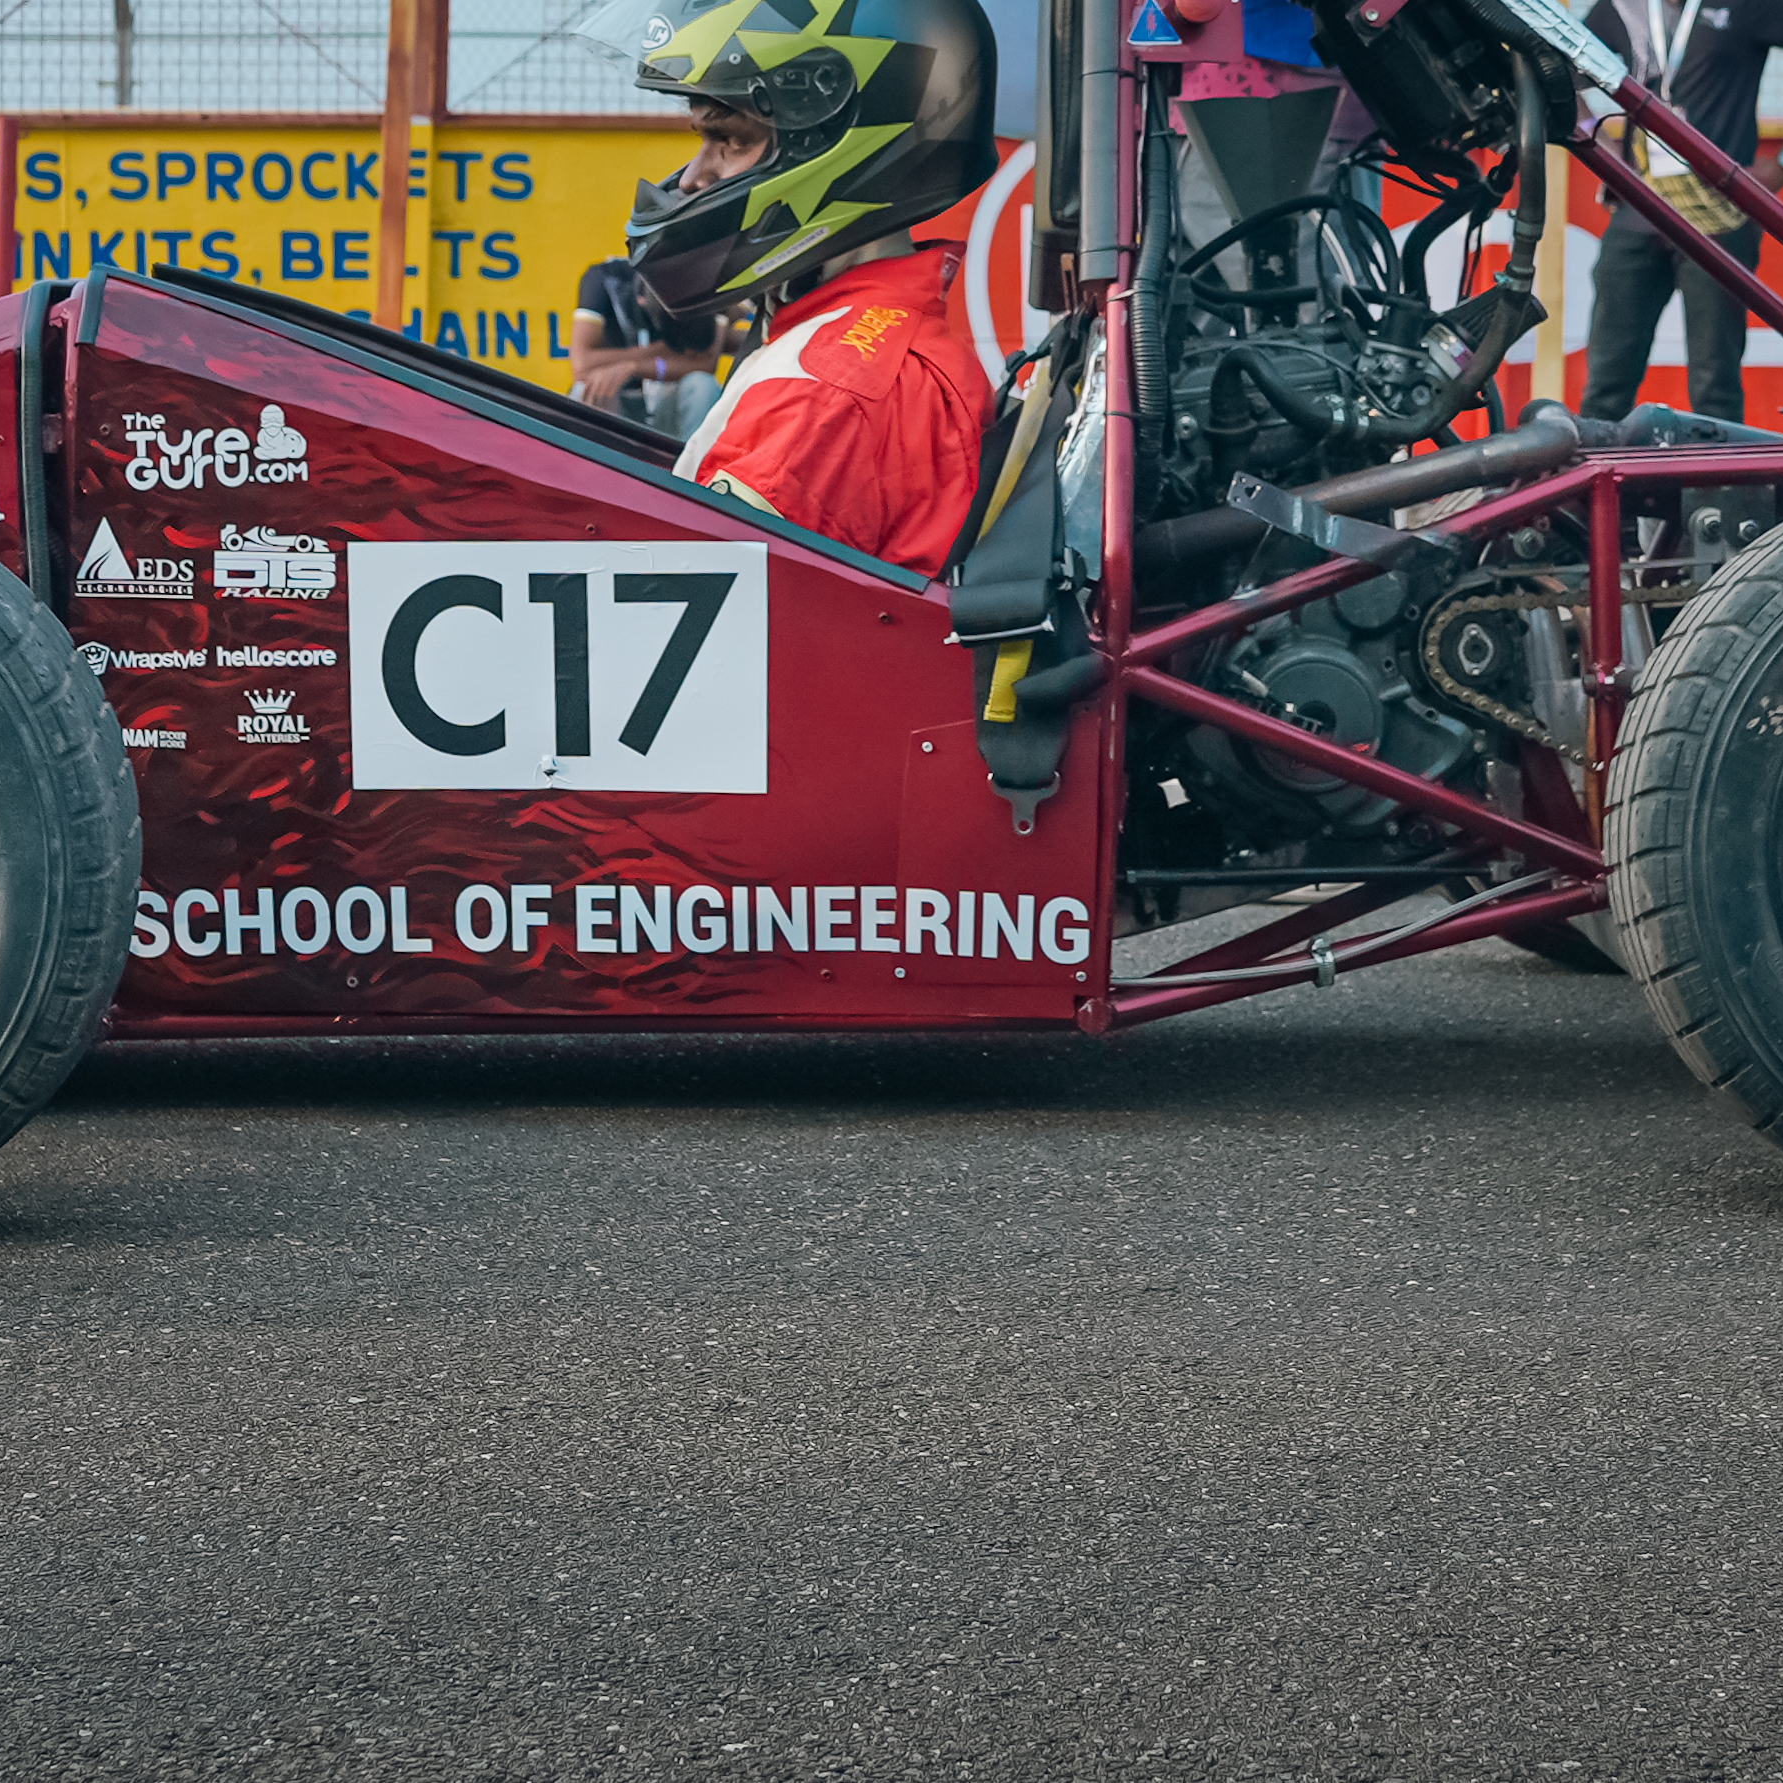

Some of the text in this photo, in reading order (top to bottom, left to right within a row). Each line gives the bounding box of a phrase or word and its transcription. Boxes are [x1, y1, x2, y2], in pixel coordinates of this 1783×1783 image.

[281, 230, 522, 281] BETS
[121, 412, 166, 431] The
[136, 557, 195, 582] EDS
[221, 587, 331, 600] RACING
[216, 645, 338, 667] helloscore
[380, 571, 739, 758] C17
[237, 714, 312, 734] ROYAL
[121, 727, 158, 749] NAM
[128, 883, 1092, 965] SCHOOL OF ENGINEERING
